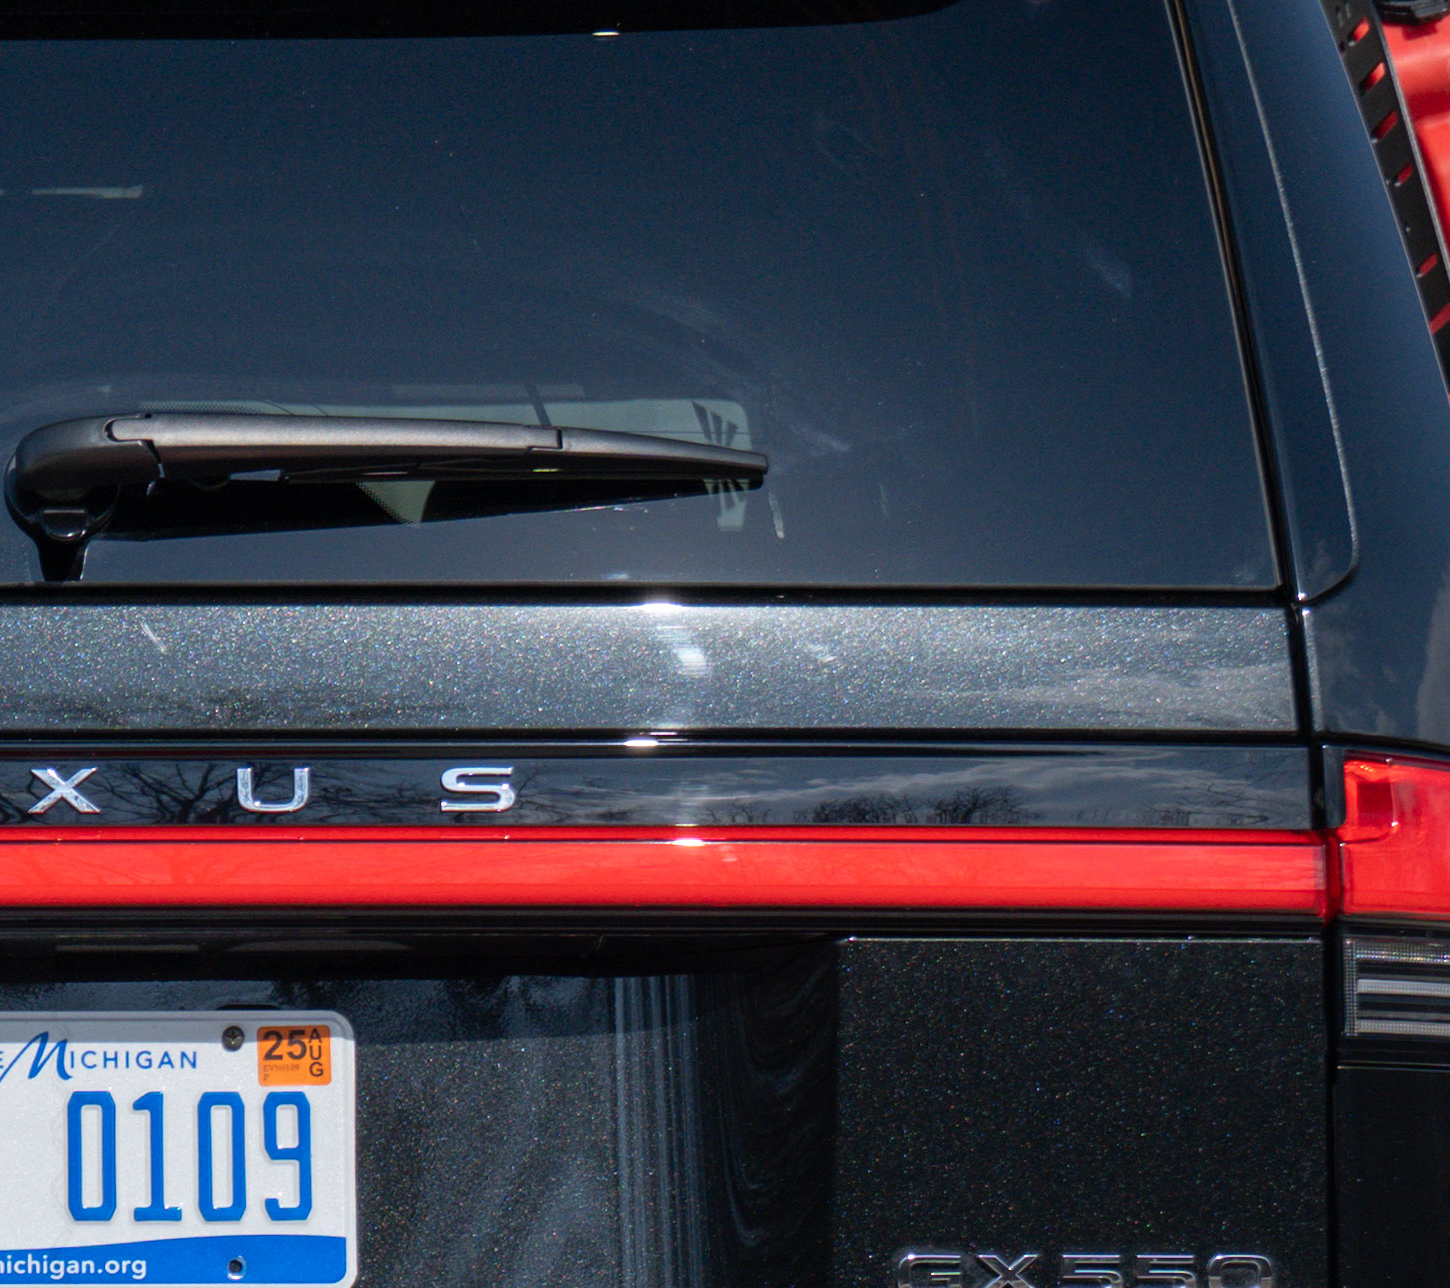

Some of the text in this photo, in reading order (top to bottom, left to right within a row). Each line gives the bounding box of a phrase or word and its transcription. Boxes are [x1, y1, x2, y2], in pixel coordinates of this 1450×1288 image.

[263, 1029, 308, 1061] 25
[309, 1027, 324, 1077] AUG
[66, 1090, 313, 1222] 0109
